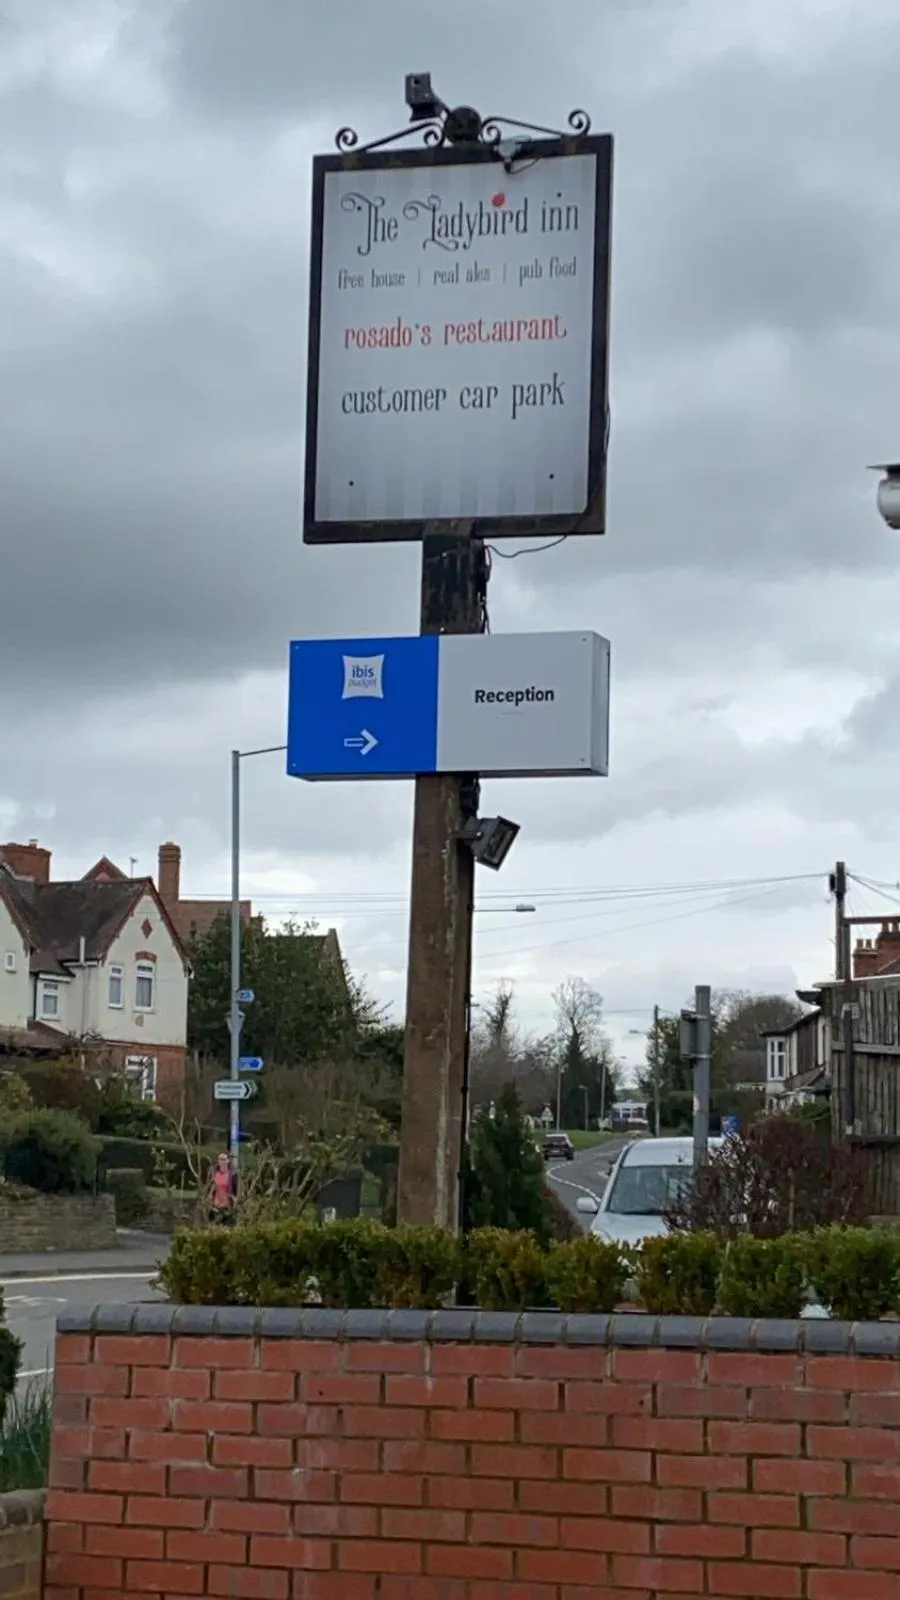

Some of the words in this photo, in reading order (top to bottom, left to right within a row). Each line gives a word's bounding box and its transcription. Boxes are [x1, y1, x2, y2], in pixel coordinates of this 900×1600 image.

[340, 192, 398, 256] The
[403, 193, 528, 251] Ladybird
[541, 192, 579, 233] inn
[337, 267, 364, 290] free
[371, 267, 405, 289] house
[432, 261, 459, 285] real
[466, 260, 491, 282] ales
[519, 257, 542, 288] pub
[549, 256, 576, 279] food
[344, 316, 432, 350] rosado's
[444, 314, 567, 345] restaurant
[341, 384, 447, 414] customer
[459, 385, 498, 412] car
[512, 372, 565, 420] park
[352, 664, 375, 678] ibis
[474, 685, 555, 707] Reception
